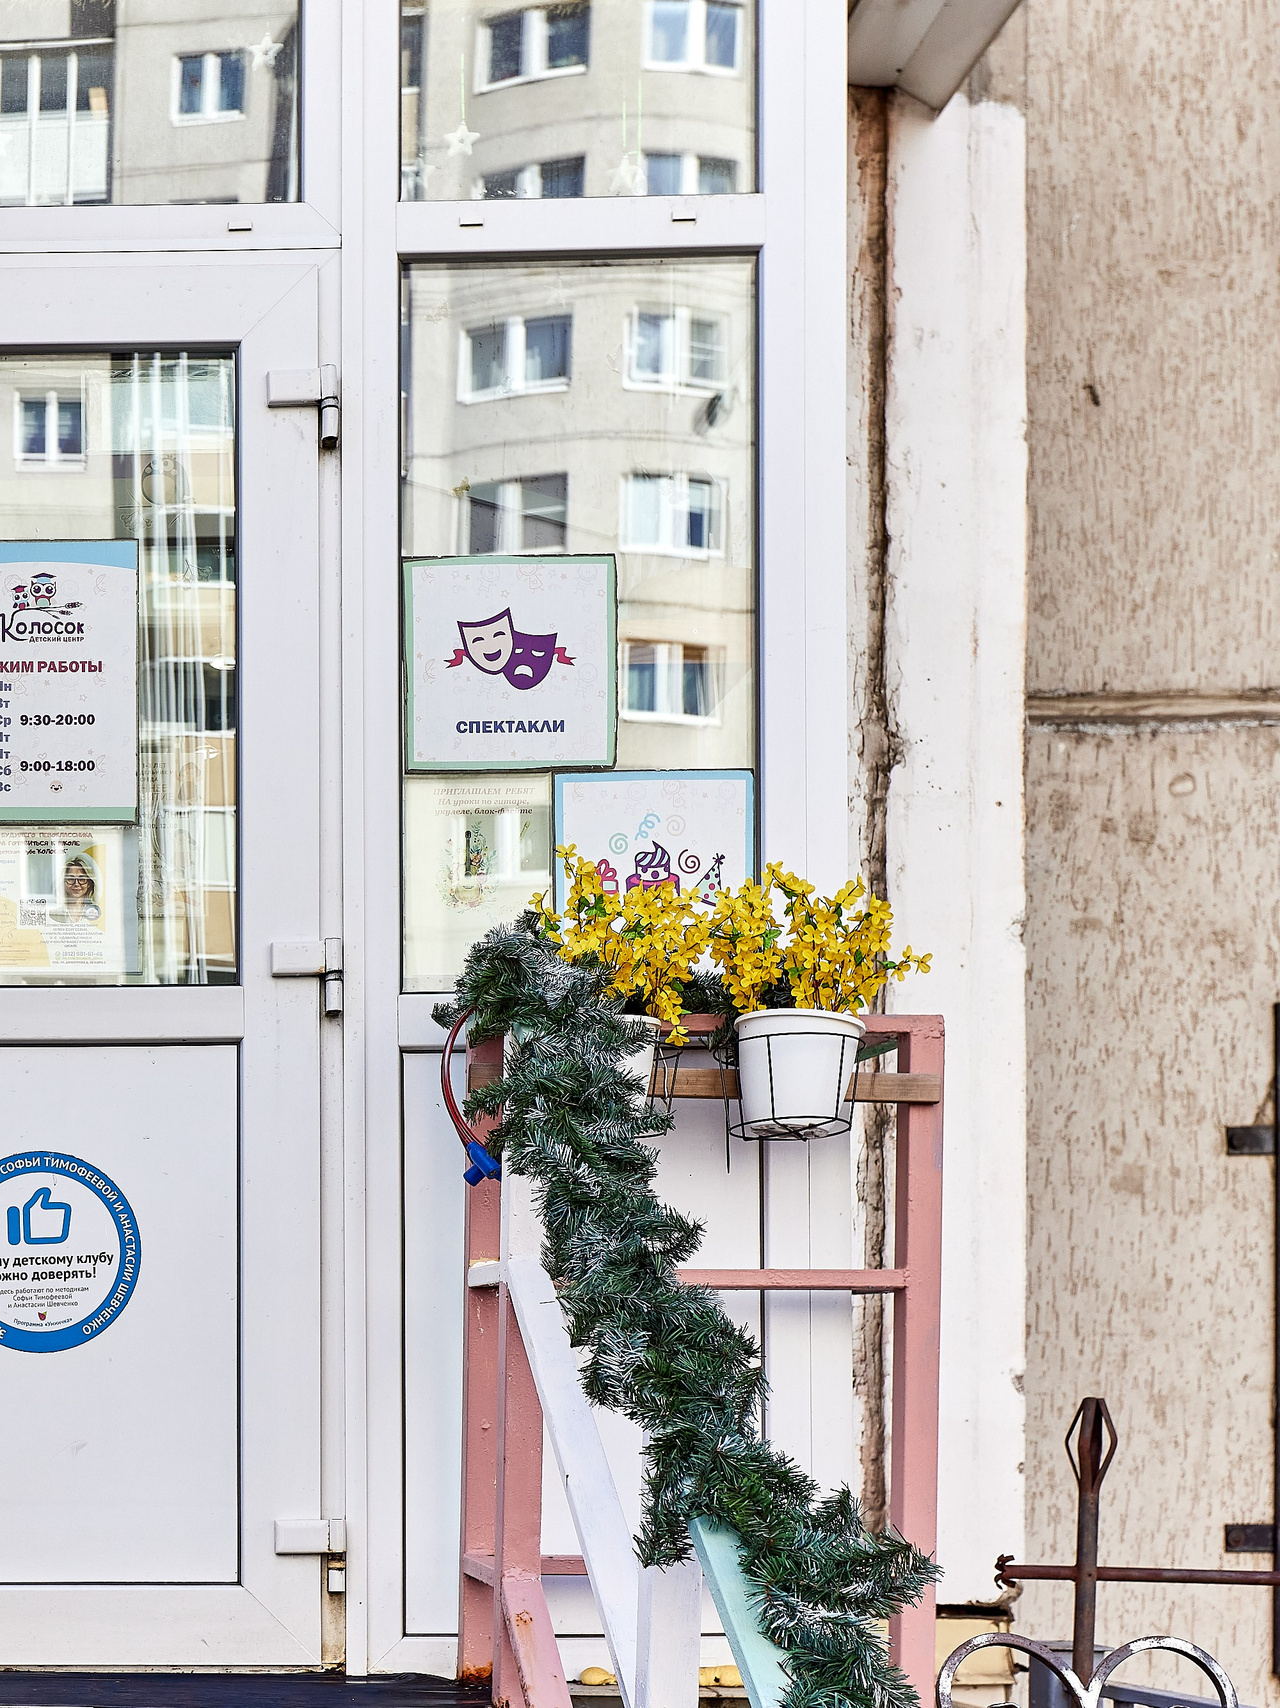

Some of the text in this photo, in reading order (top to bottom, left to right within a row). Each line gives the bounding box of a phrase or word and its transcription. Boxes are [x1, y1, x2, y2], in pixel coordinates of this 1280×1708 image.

[37, 660, 103, 673] РАБОТЫ
[19, 713, 96, 726] 9:30-20:00
[455, 719, 565, 734] СПЕКТАКЛИ
[19, 759, 96, 772] 9:00-18:00
[433, 787, 535, 796] ПРИГЛАШАЕМ РЕБЯТ
[453, 799, 480, 807] уроки
[0, 1157, 41, 1175] СОФЬИ
[44, 1157, 119, 1203] ТИМОФЕЕВОЙ
[113, 1201, 125, 1212] И
[118, 1213, 136, 1281] АНАСТАСИИ
[12, 1255, 73, 1268] детскому
[76, 1251, 114, 1266] клубу
[31, 1266, 97, 1282] доверять!
[13, 1293, 72, 1302] Софьи Тимофеевой
[16, 1287, 44, 1295] работают
[82, 1283, 129, 1335] ШЕВЧЕНКО
[13, 1318, 43, 1327] Программа
